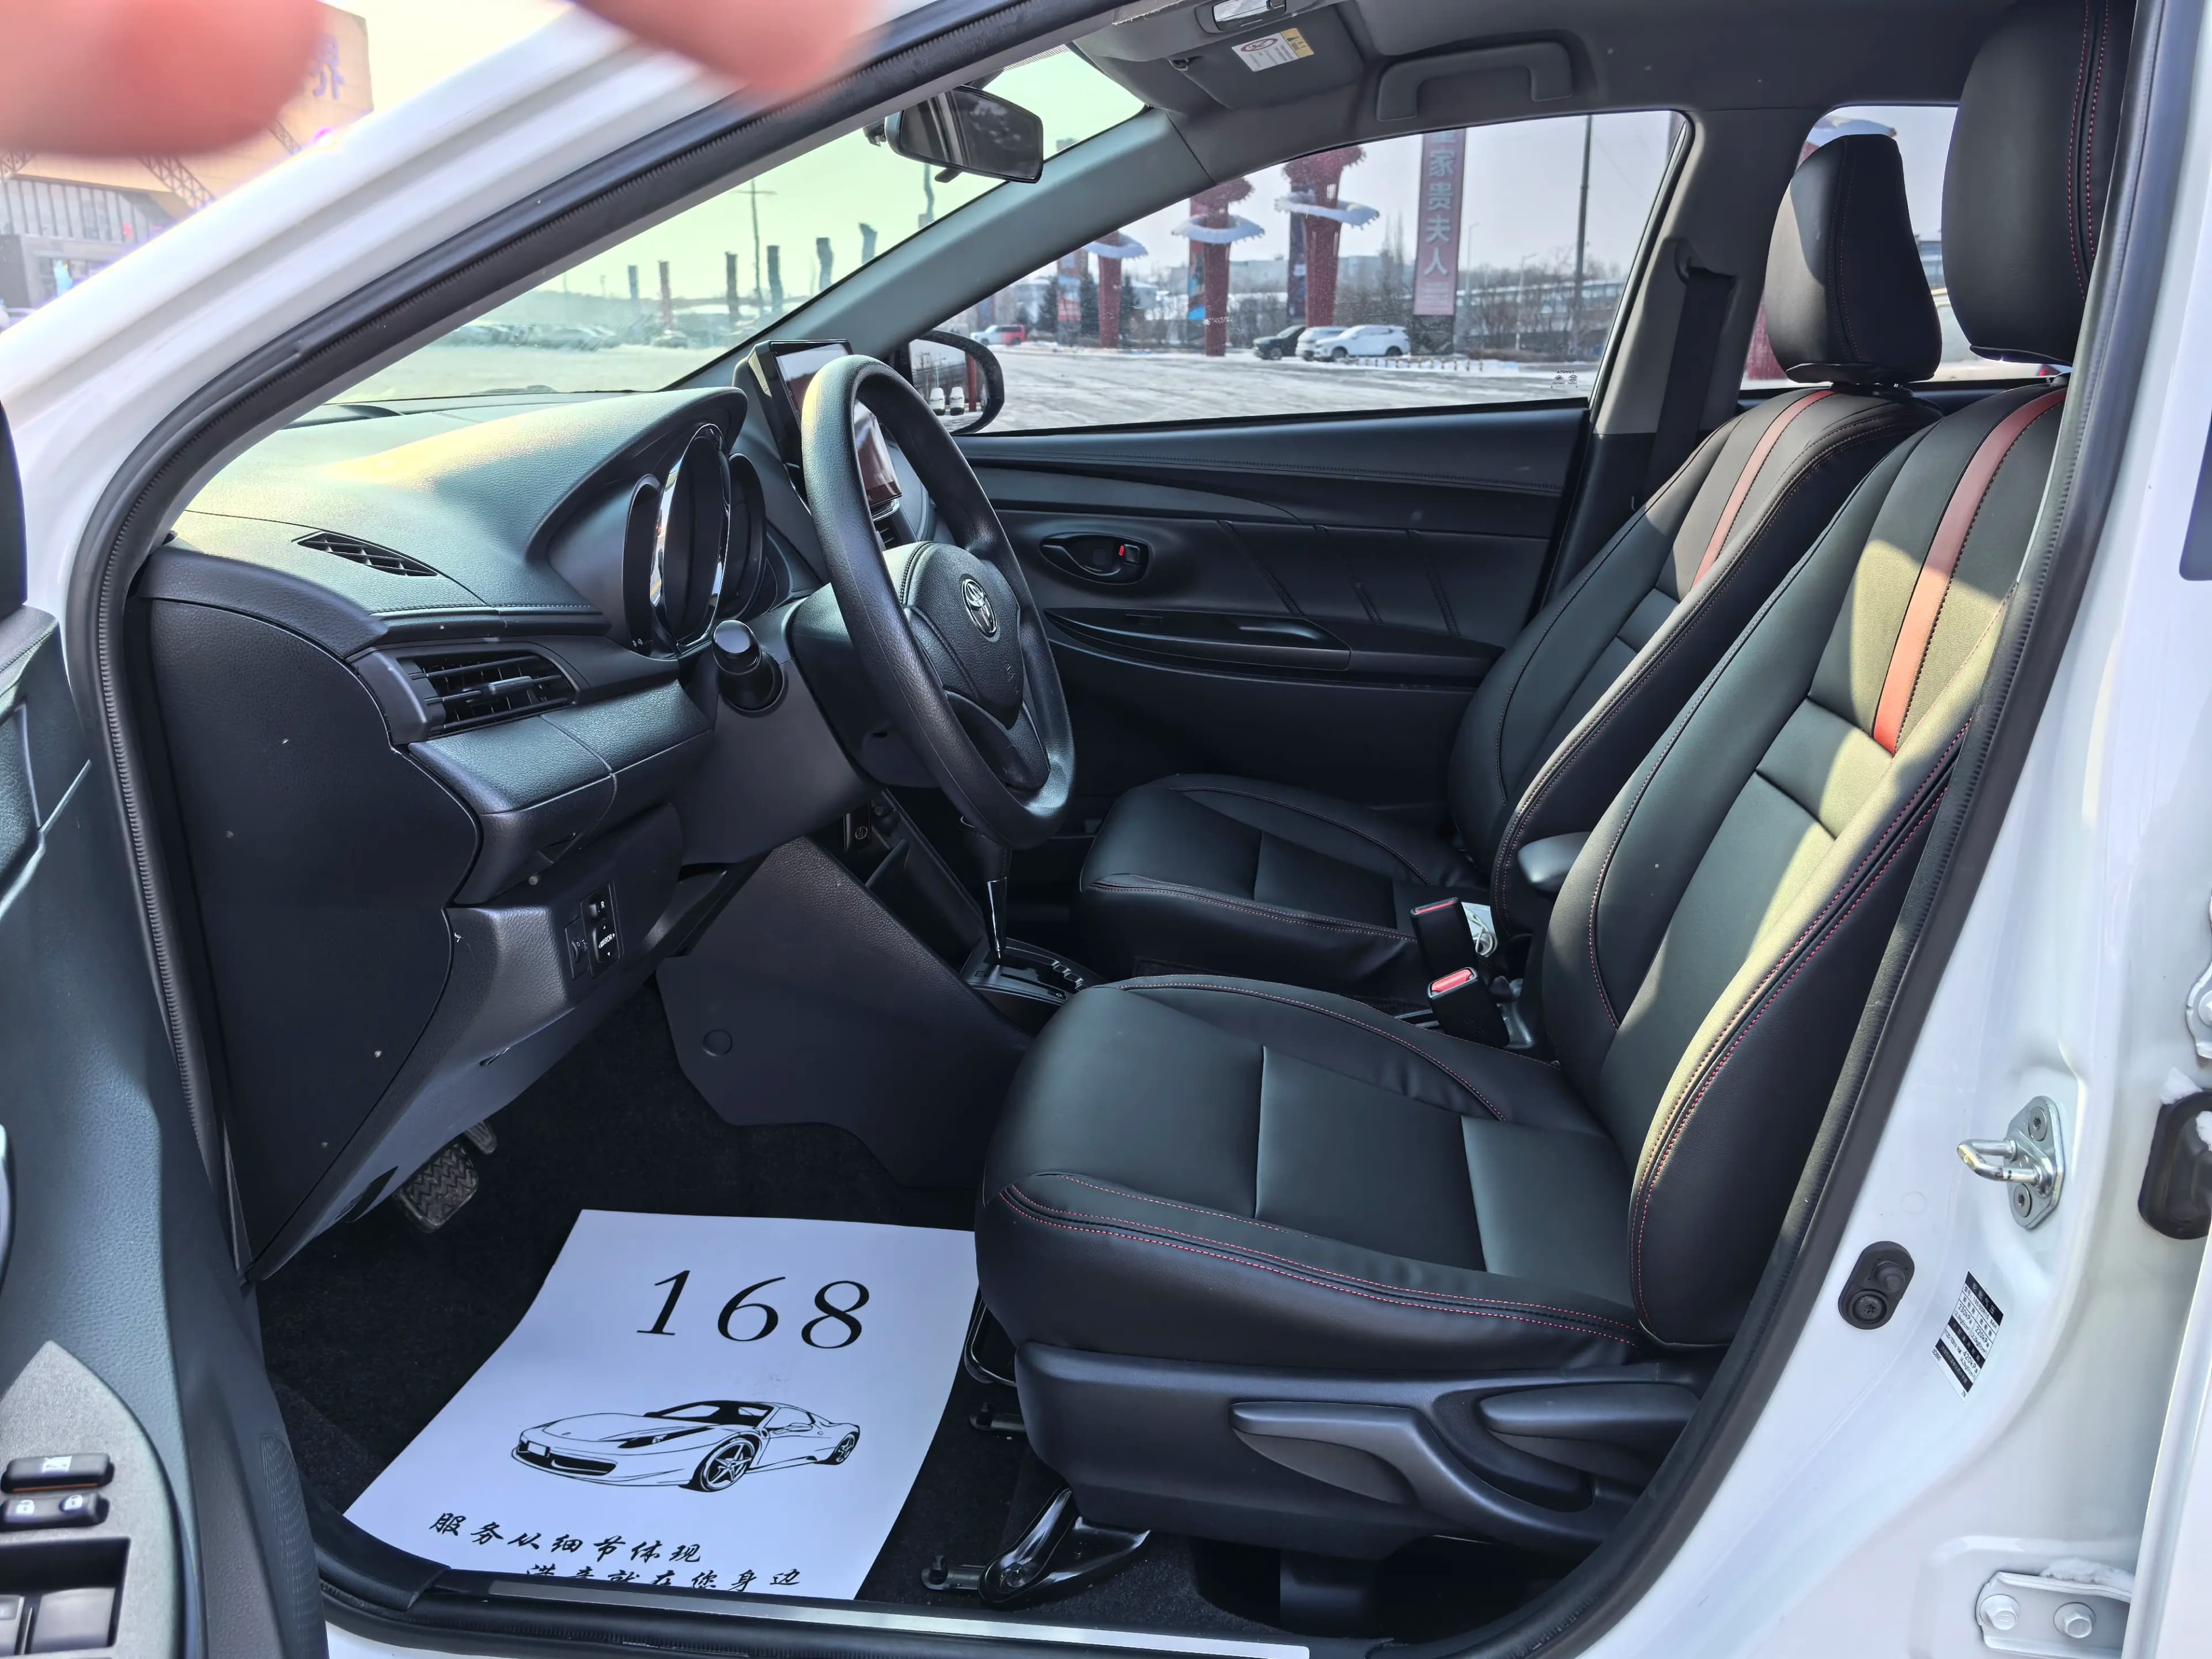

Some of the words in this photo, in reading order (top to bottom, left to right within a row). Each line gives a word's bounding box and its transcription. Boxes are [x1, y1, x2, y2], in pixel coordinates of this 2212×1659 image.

[600, 933, 613, 948] MIRROR
[637, 1270, 870, 1349] 168
[429, 1513, 701, 1563] 服务从细节体现
